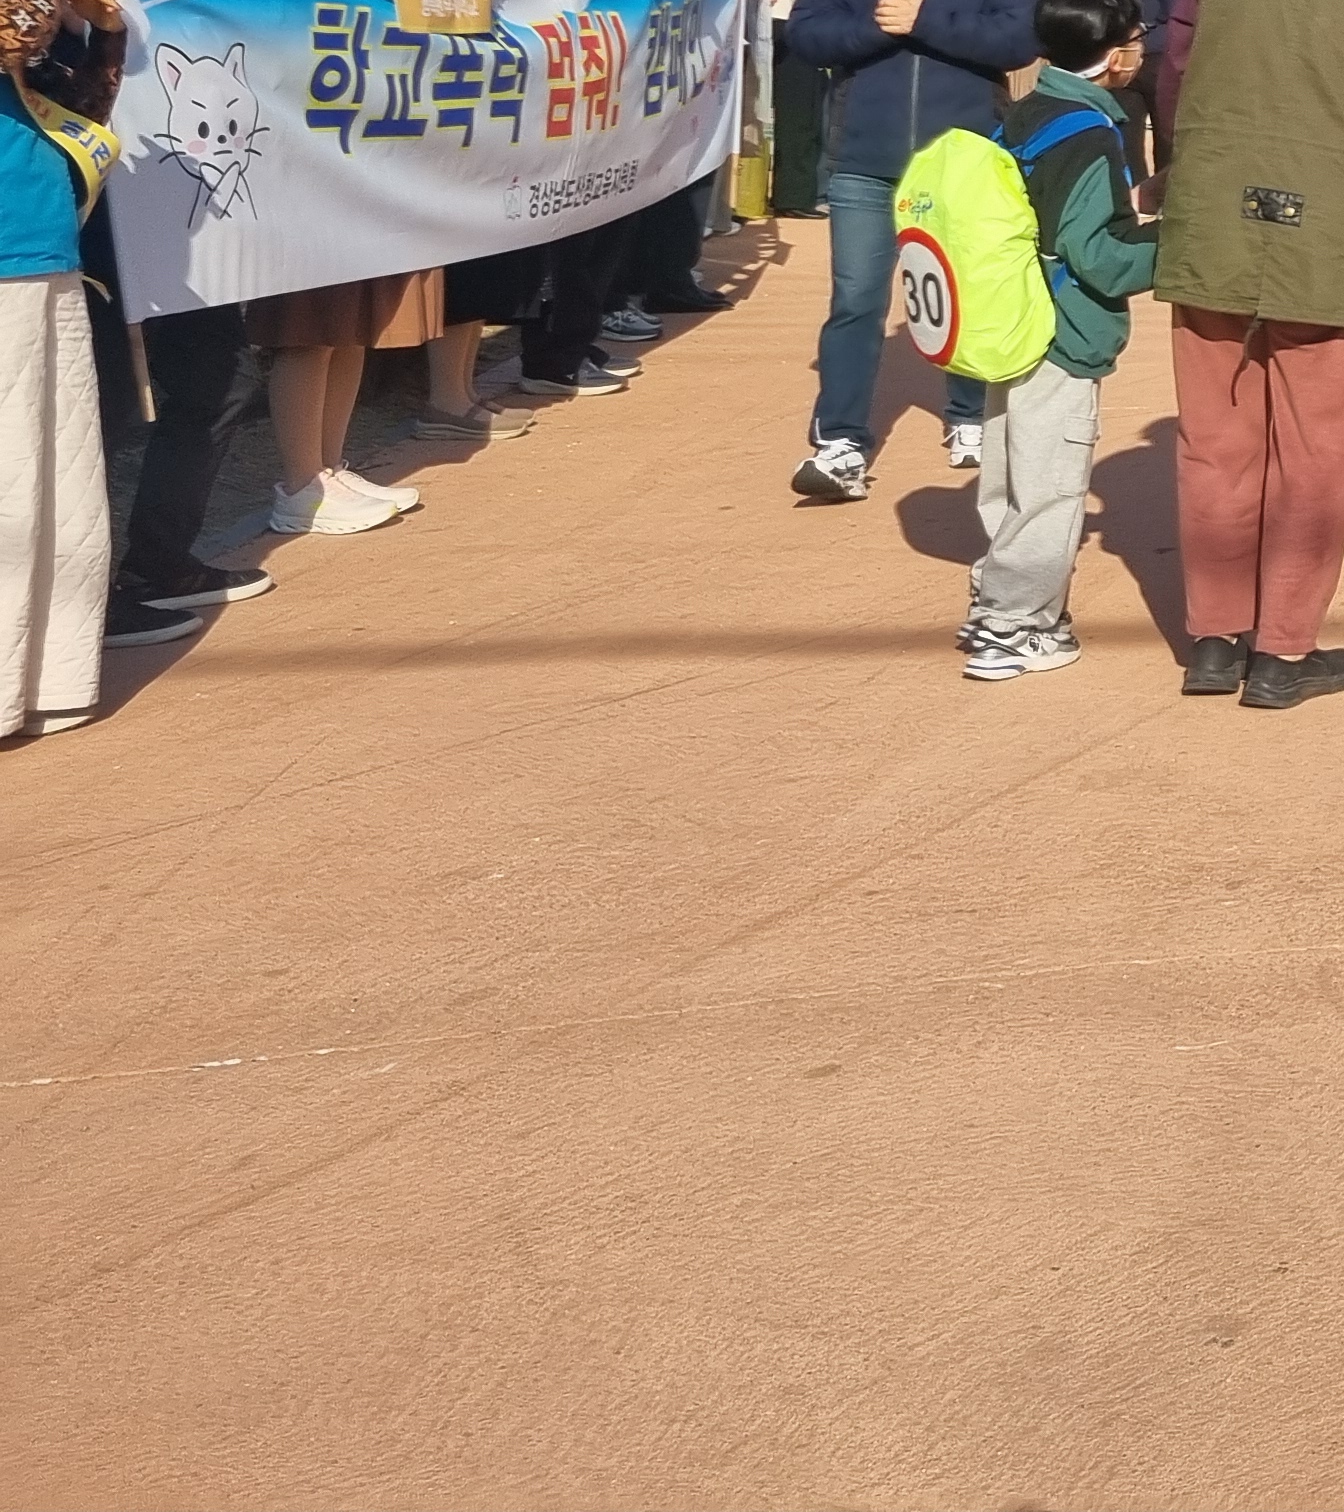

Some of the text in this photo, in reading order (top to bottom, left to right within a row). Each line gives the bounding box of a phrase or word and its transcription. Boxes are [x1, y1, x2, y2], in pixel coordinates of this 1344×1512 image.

[528, 11, 628, 141] 멈춰!
[528, 158, 640, 219] 경상남도산청교육지원청
[902, 268, 945, 329] 30
